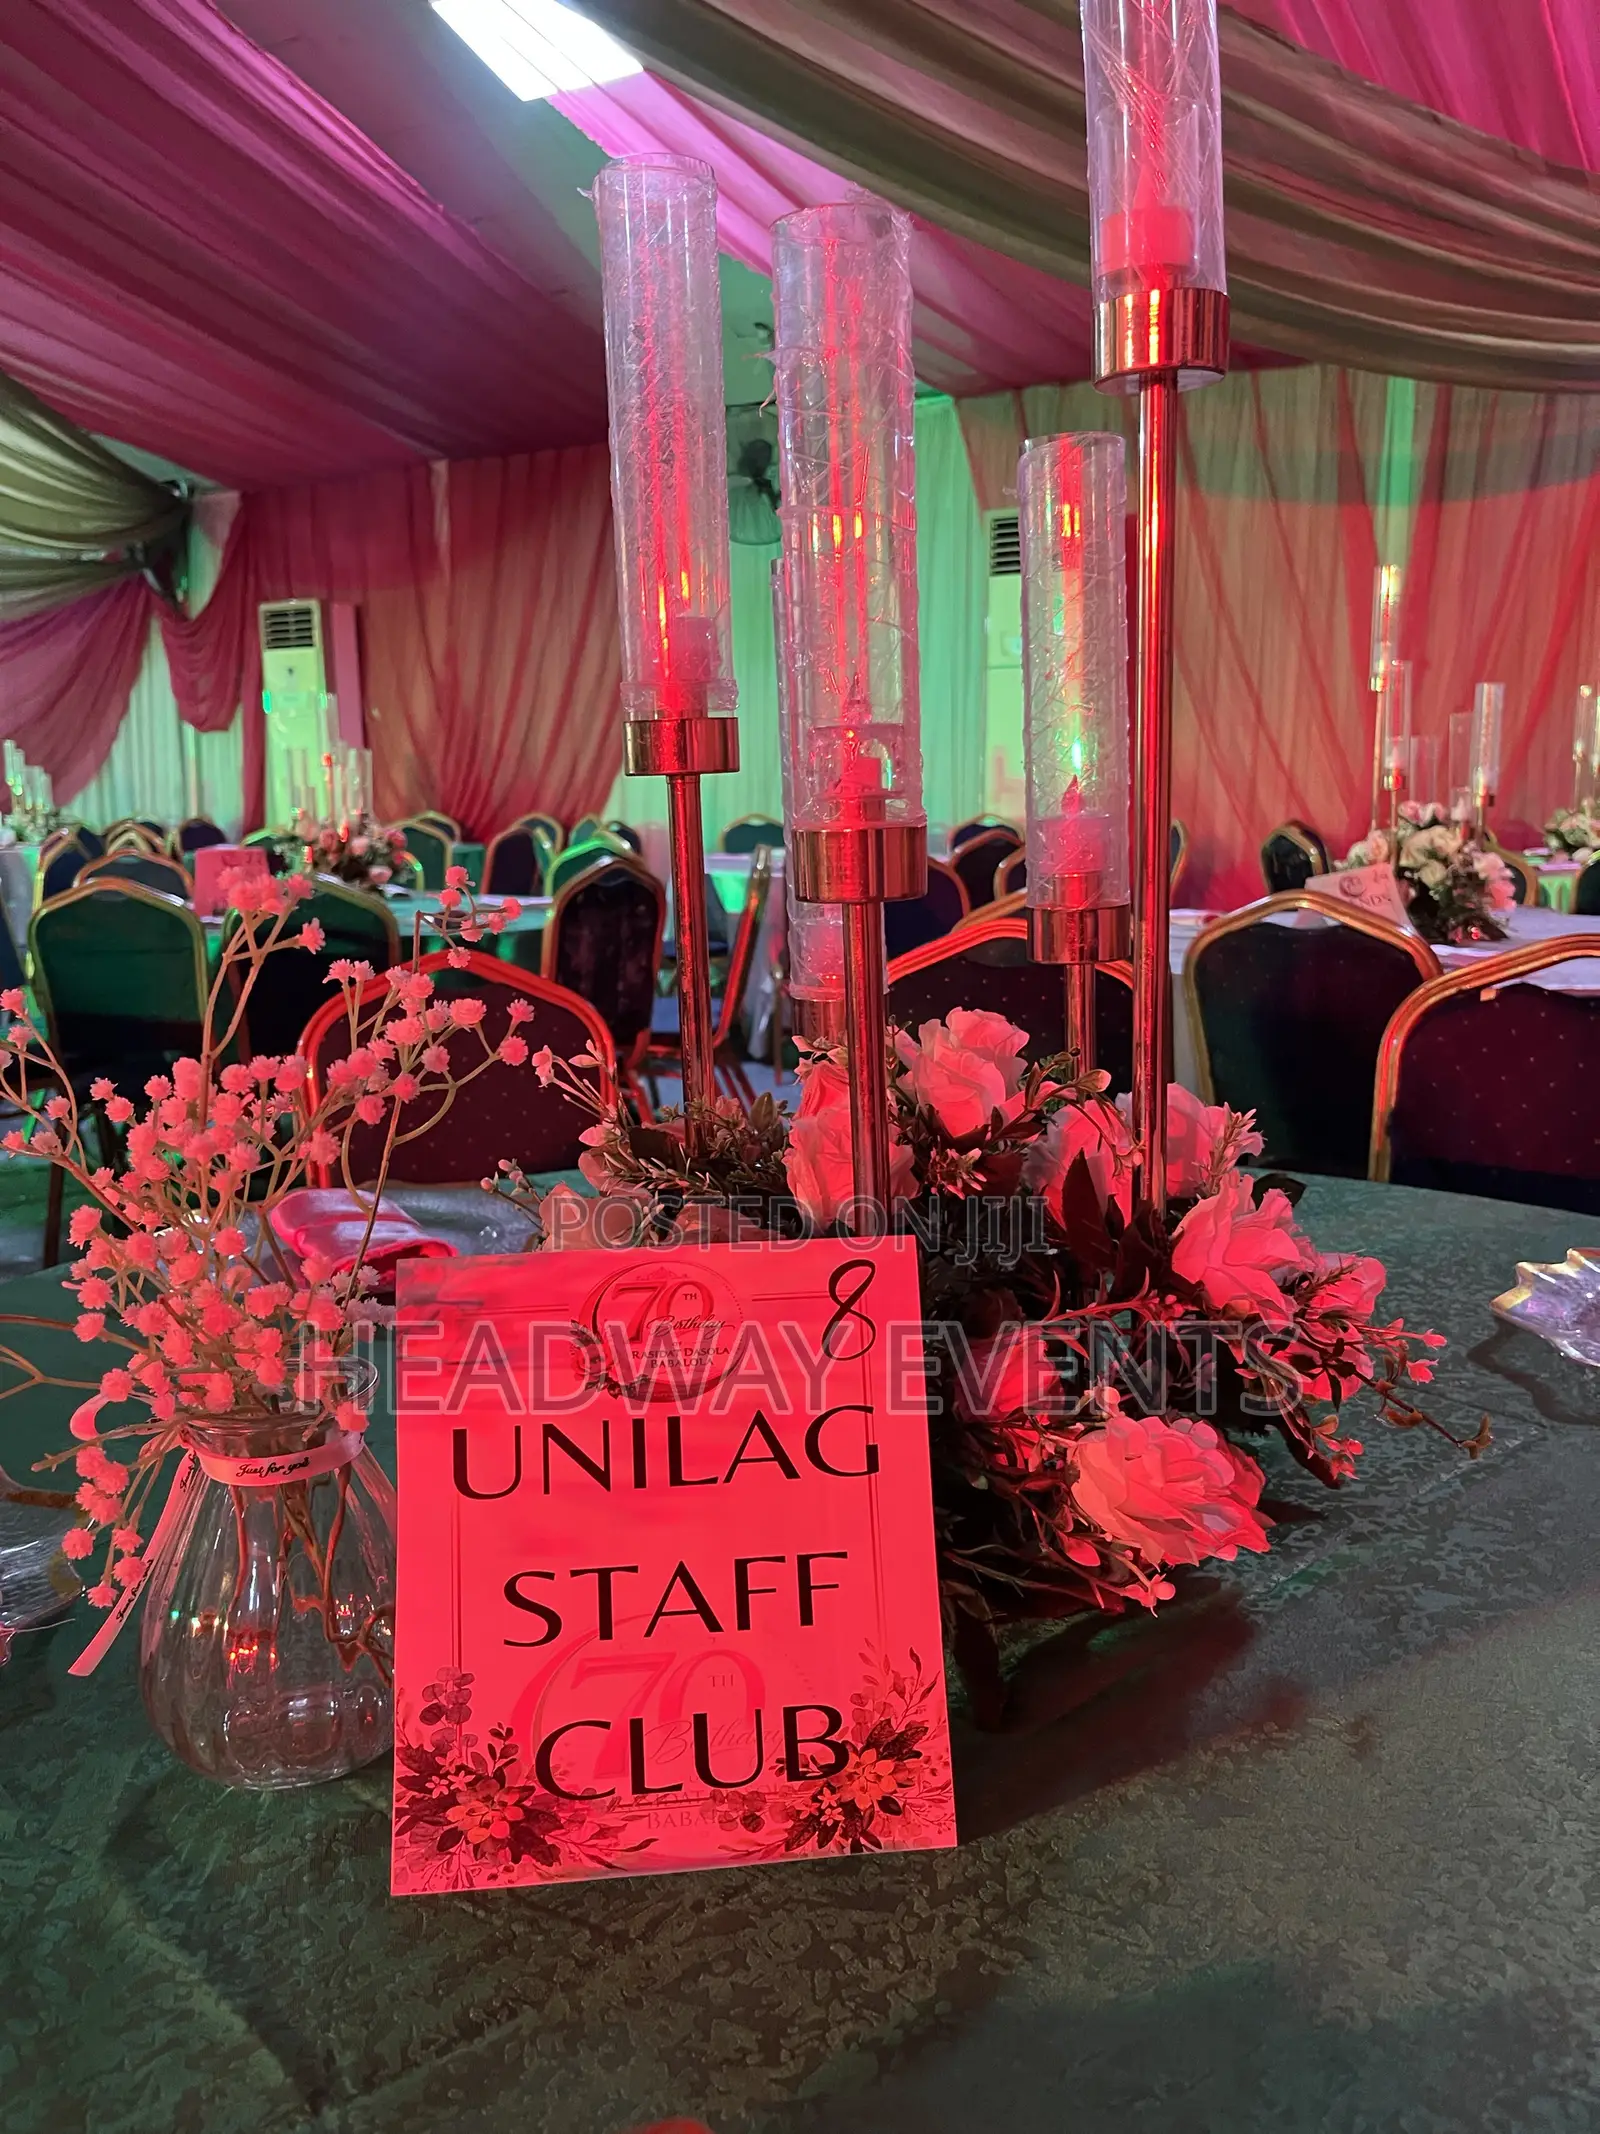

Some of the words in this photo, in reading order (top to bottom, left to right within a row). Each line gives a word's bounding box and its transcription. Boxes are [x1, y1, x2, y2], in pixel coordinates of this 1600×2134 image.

[611, 1280, 715, 1344] 70
[646, 1313, 736, 1340] Birthday
[682, 1293, 698, 1301] TH
[821, 1259, 877, 1362] 8
[684, 1347, 730, 1357] DASOLA
[451, 1404, 881, 1501] UNILAG
[502, 1550, 849, 1649] STAFF
[533, 1702, 851, 1801] CLUB
